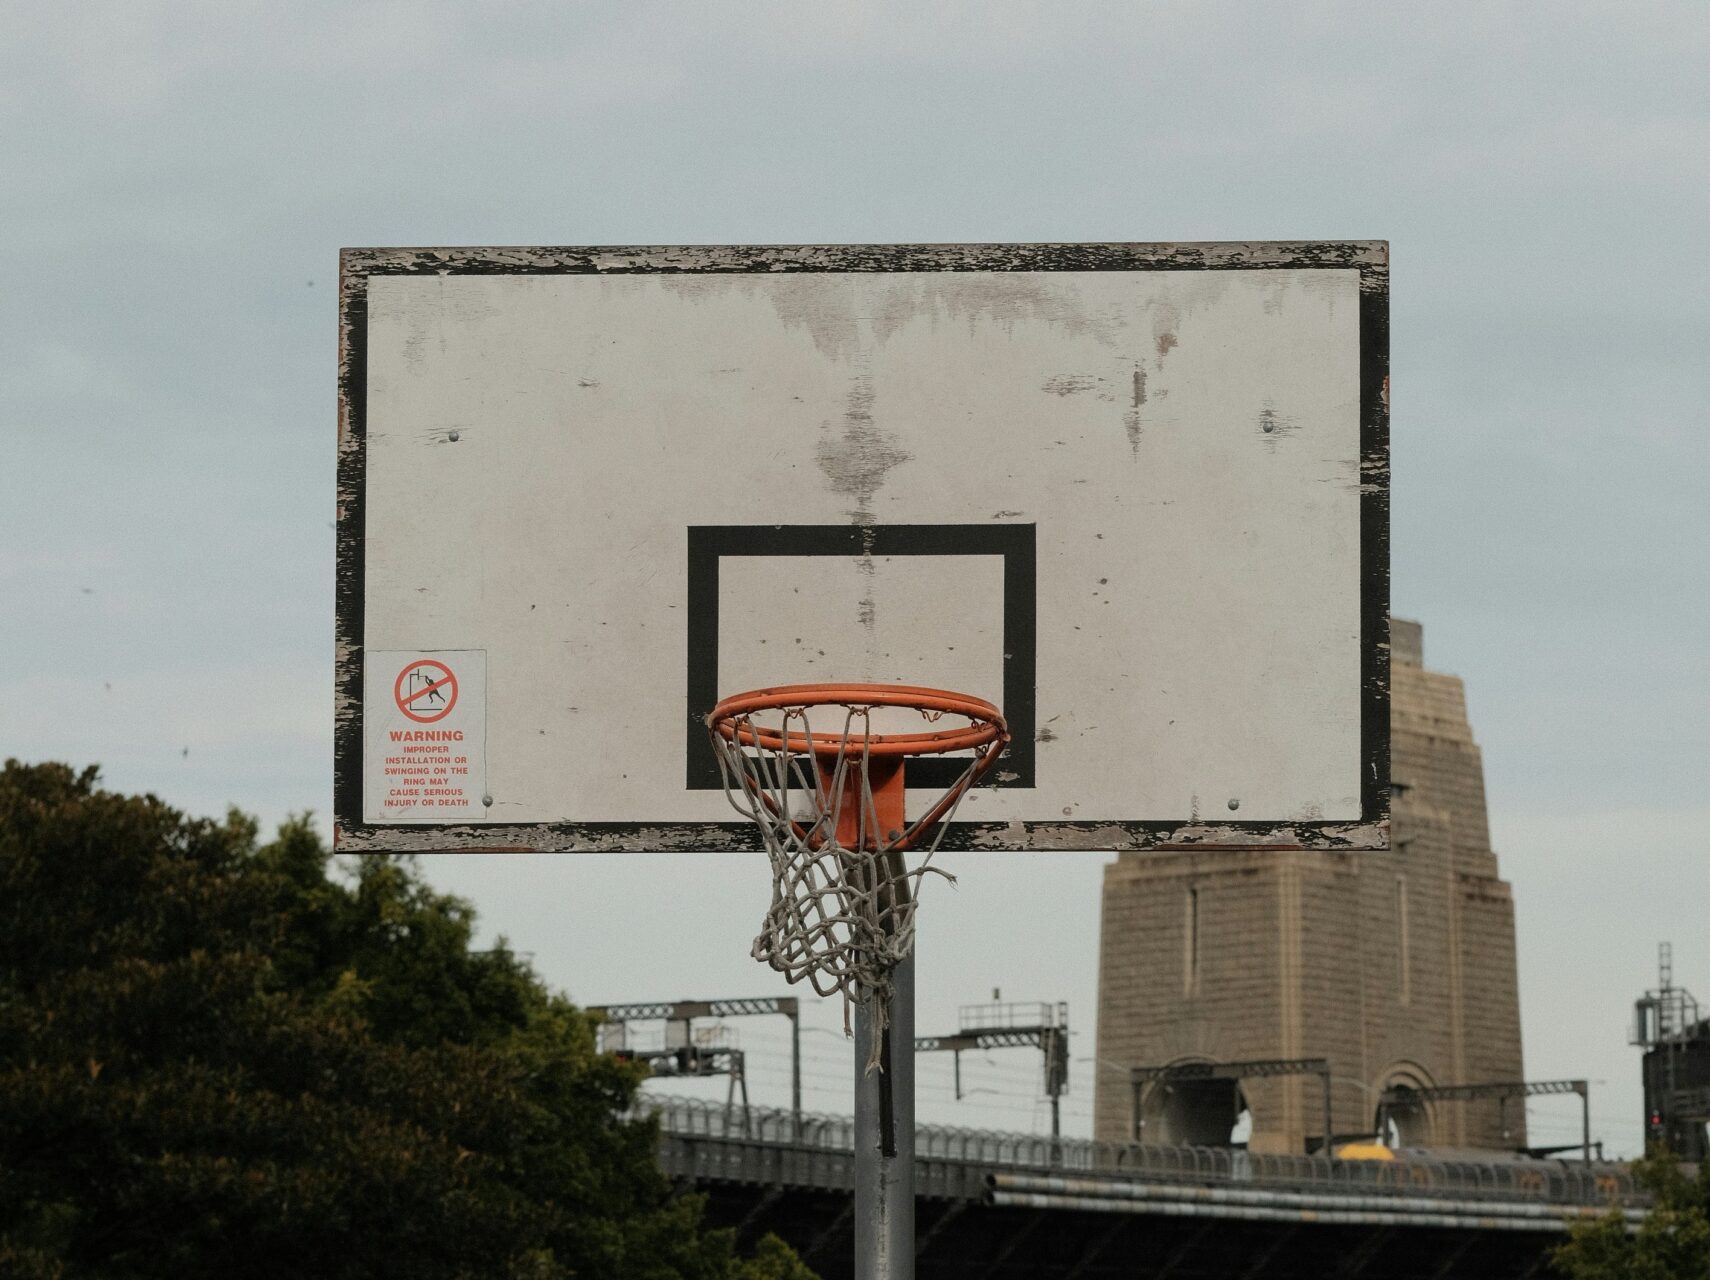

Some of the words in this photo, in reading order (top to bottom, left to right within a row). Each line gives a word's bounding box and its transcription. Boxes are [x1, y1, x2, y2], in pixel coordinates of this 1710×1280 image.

[390, 731, 464, 742] WARNING
[403, 745, 449, 753] IMPROPER
[385, 756, 450, 764] INSTALLATION
[384, 767, 430, 775] SWINGING
[433, 767, 447, 775] ON
[450, 767, 468, 775] THE
[403, 778, 426, 786] RING
[429, 778, 449, 786] MAY
[389, 788, 420, 796] CAUSE
[384, 799, 417, 807] INJURY
[421, 799, 434, 807] OR
[438, 799, 469, 807] DEATH
